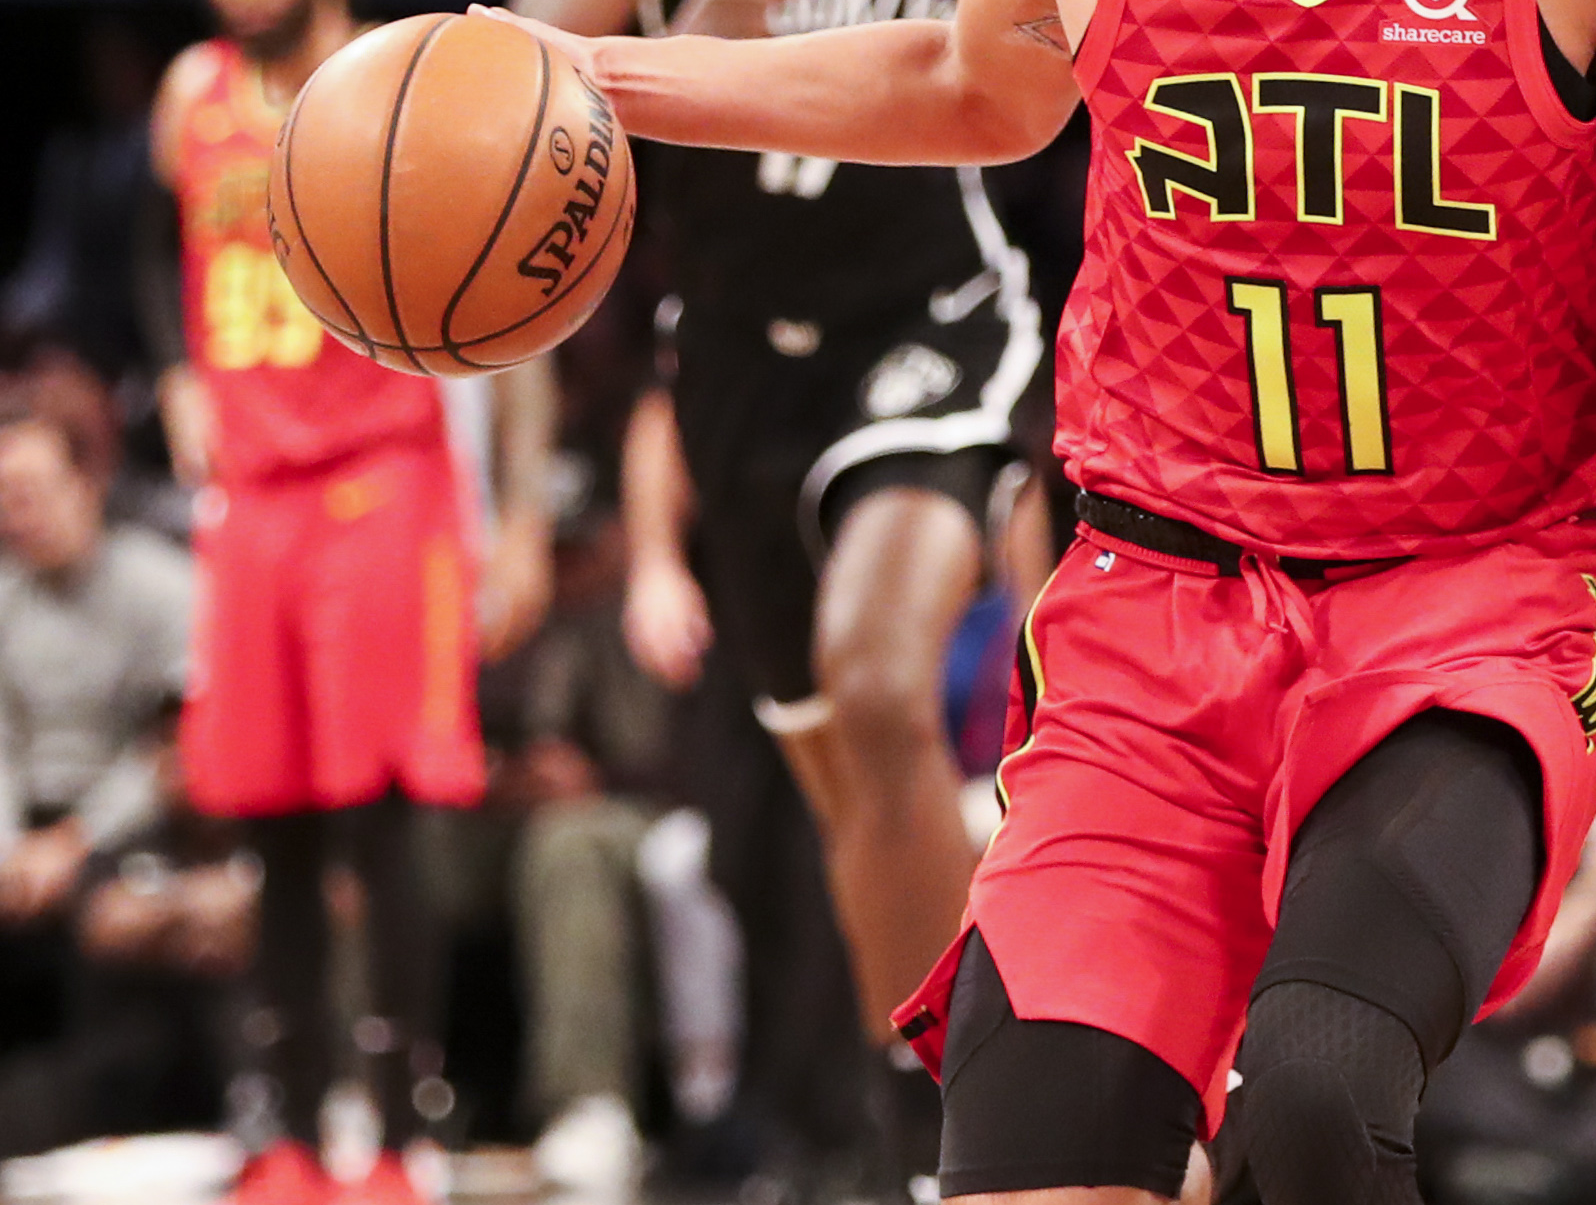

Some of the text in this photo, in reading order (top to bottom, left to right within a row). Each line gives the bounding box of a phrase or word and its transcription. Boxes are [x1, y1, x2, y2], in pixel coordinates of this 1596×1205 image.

[1382, 22, 1487, 45] sharecare
[1124, 71, 1497, 241] ATL
[1224, 274, 1395, 477] 11
